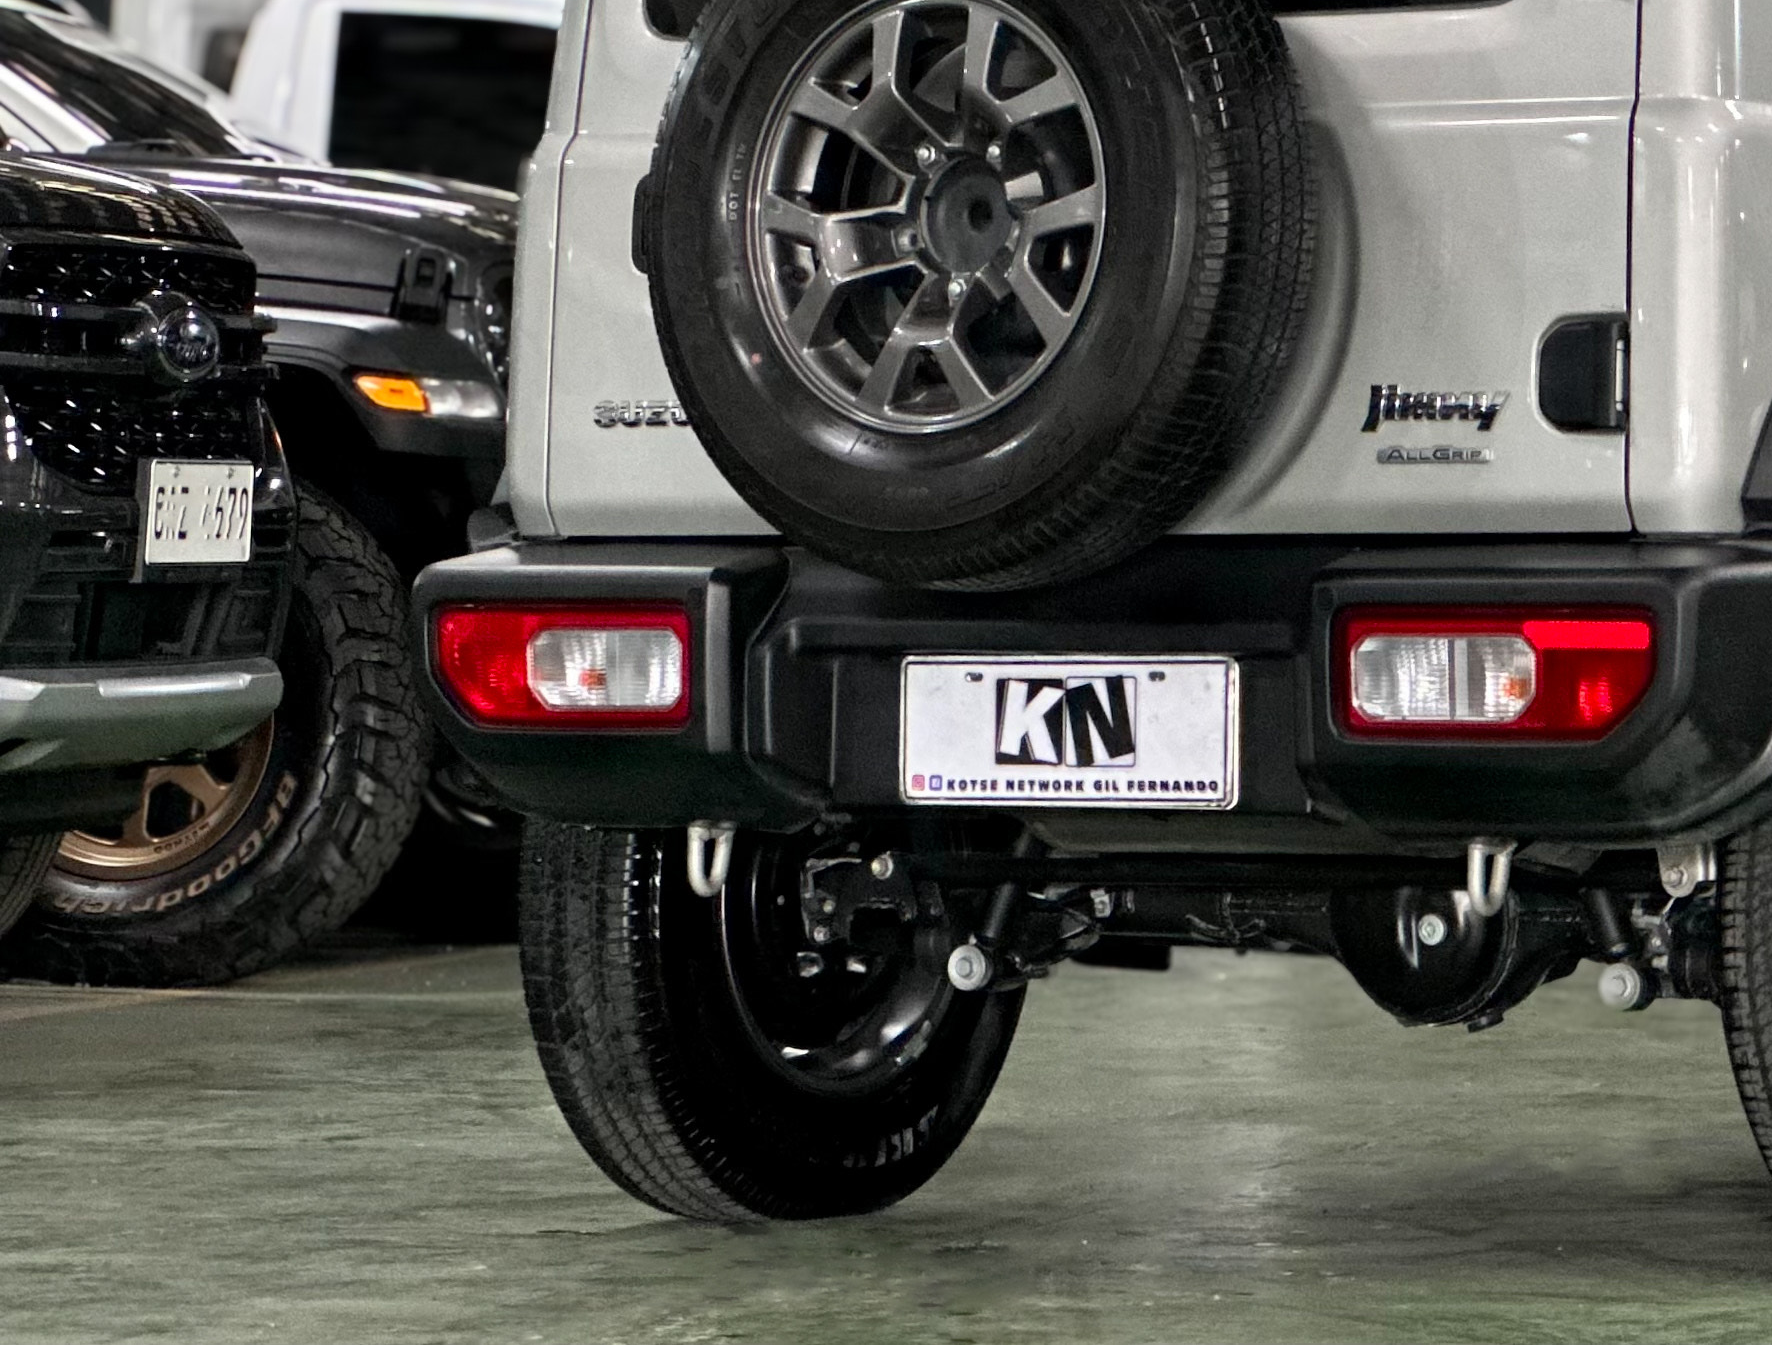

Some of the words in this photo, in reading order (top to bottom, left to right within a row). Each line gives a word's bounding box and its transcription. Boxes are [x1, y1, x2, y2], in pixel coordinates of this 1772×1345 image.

[995, 673, 1138, 768] KN
[946, 778, 998, 793] KOTSE
[1005, 778, 1085, 793] NETWORK
[1093, 778, 1121, 793] GIL
[1126, 778, 1219, 794] FERNANDO
